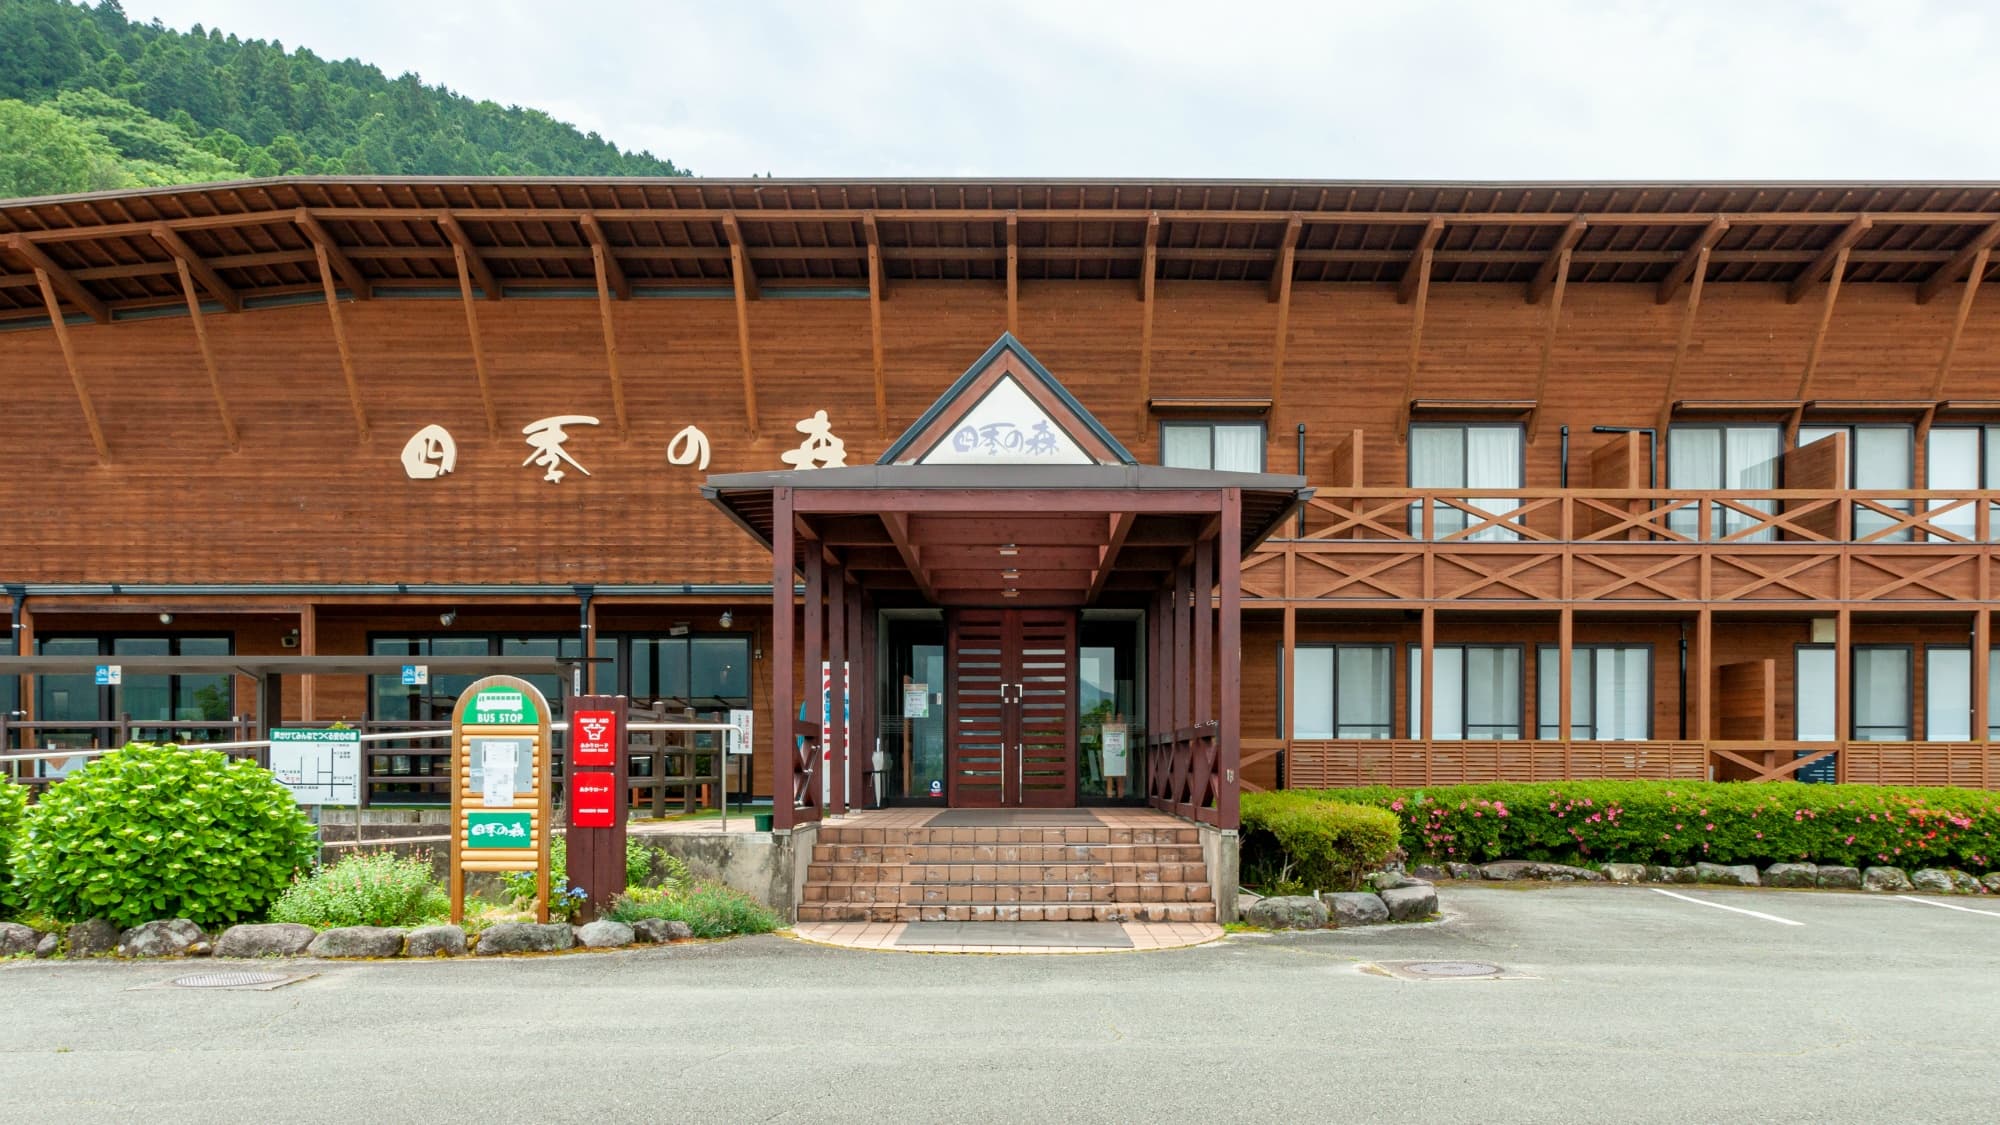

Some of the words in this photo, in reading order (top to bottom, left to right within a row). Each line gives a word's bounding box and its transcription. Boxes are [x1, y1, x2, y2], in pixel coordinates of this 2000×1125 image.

[400, 409, 847, 484] 四季の森
[952, 419, 1060, 456] 四季の森
[477, 713, 495, 723] BUS
[499, 713, 524, 723] STOP
[471, 822, 526, 837] 四季の森
